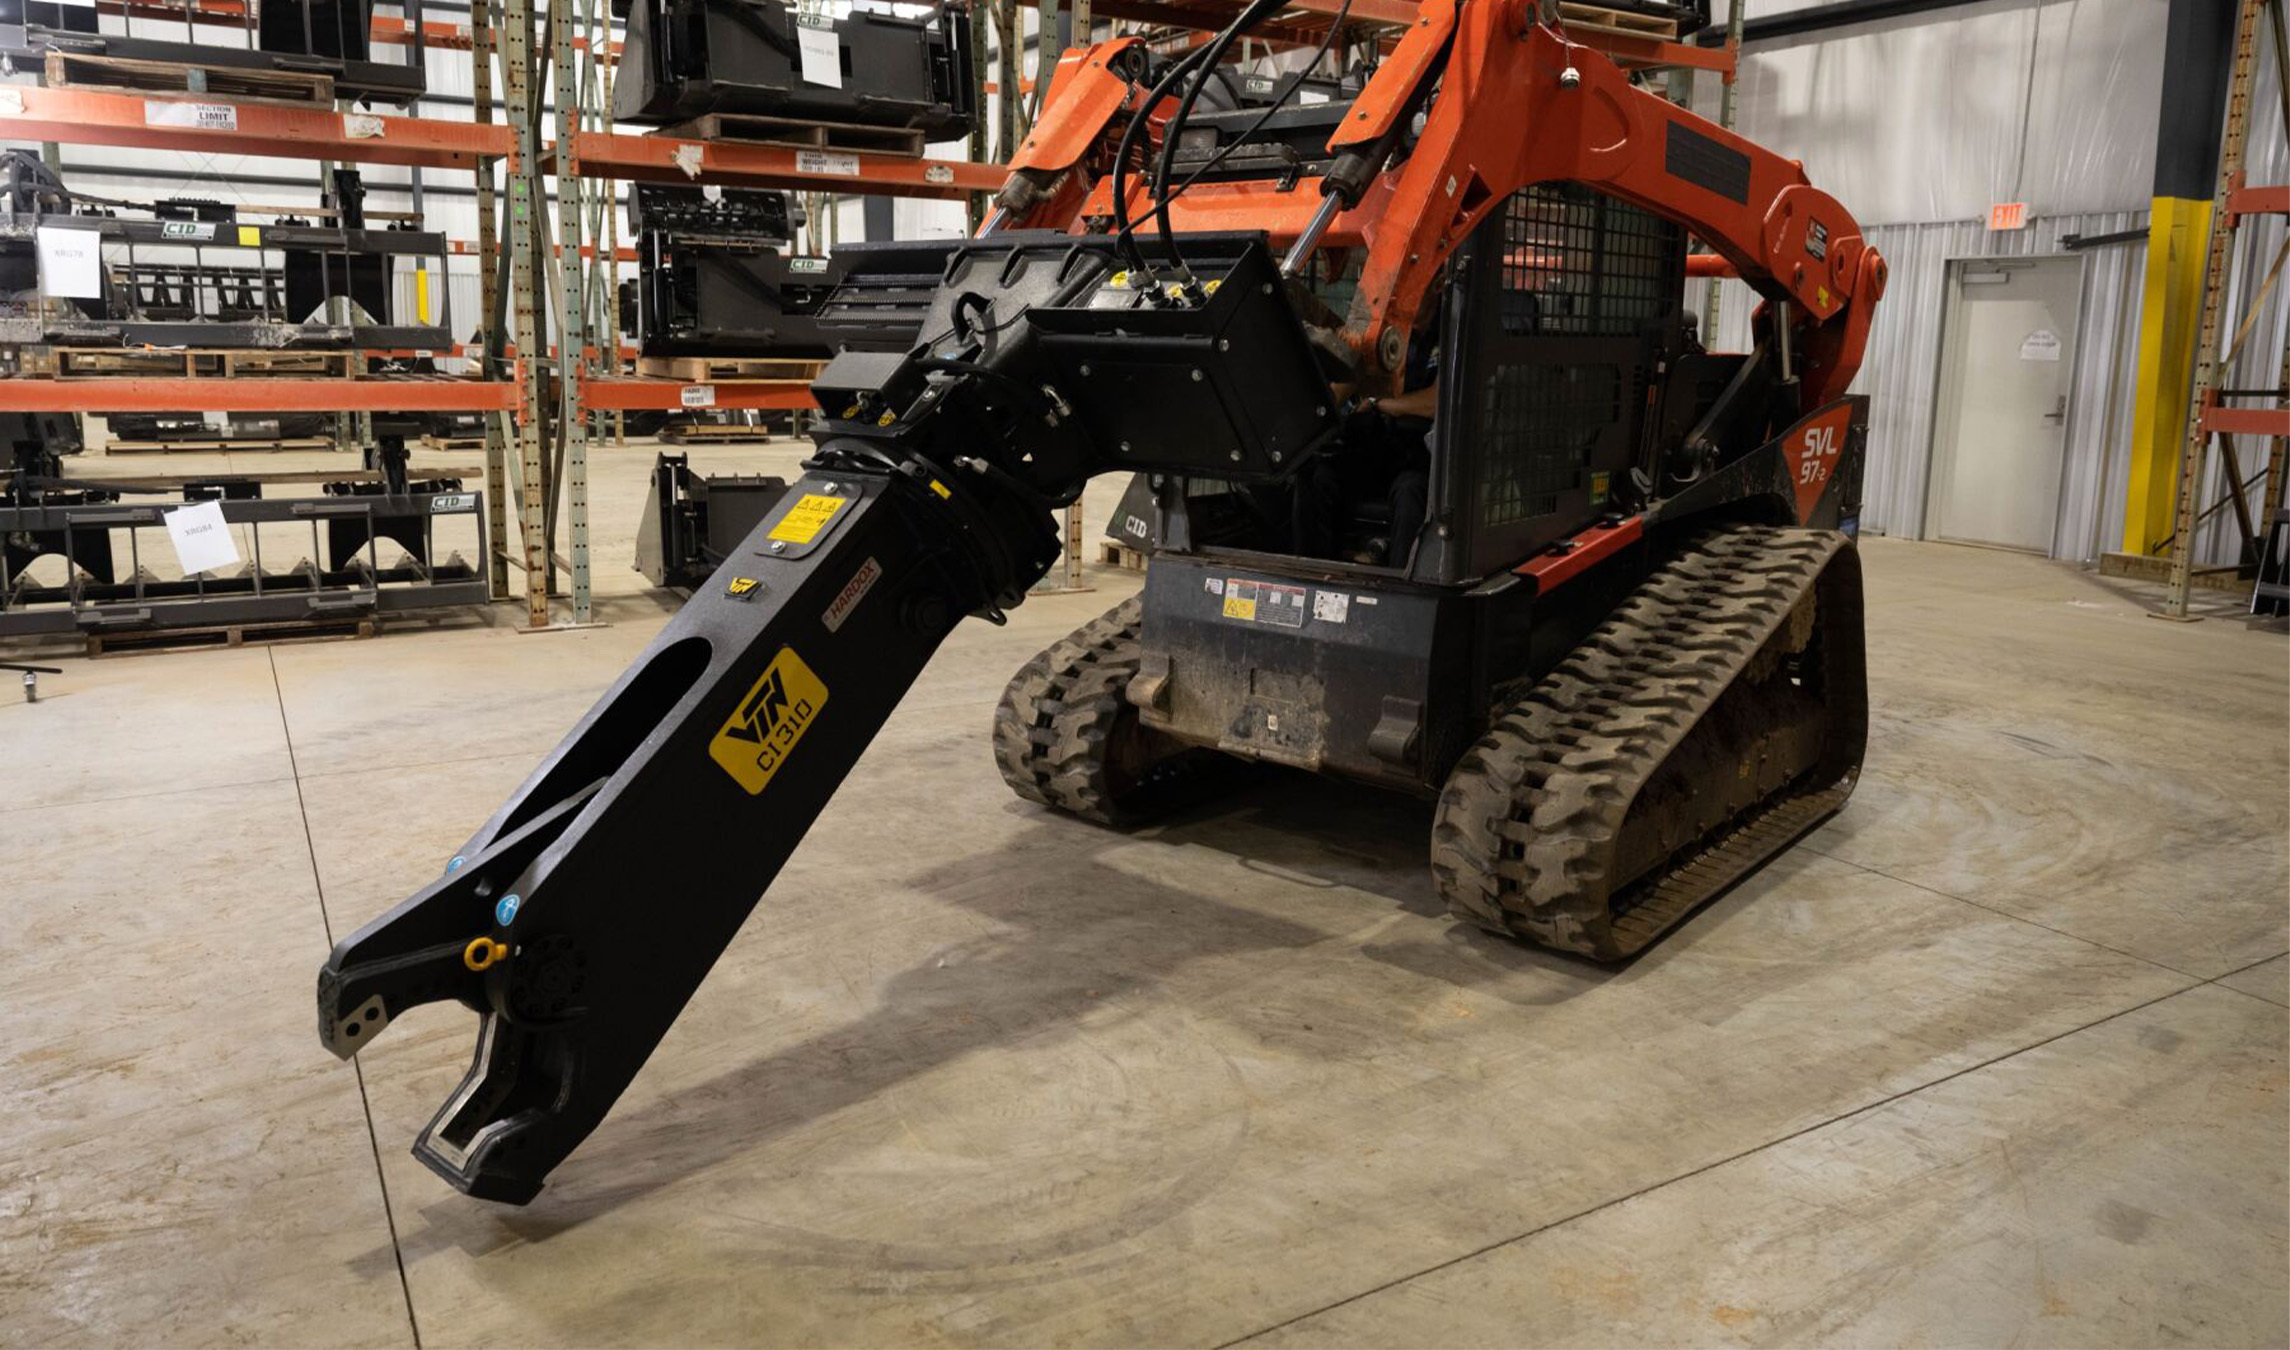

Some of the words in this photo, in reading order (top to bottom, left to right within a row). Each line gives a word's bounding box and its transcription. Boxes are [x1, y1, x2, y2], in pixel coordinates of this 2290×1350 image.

[799, 15, 821, 26] CID
[1248, 81, 1264, 90] CID
[199, 111, 229, 121] LIMIT
[1992, 203, 2022, 230] EXIT
[166, 223, 197, 235] CID
[792, 260, 815, 269] CID
[1801, 425, 1838, 459] SVL
[434, 496, 460, 507] CID
[1125, 514, 1148, 539] CID
[830, 561, 875, 619] HARDOX
